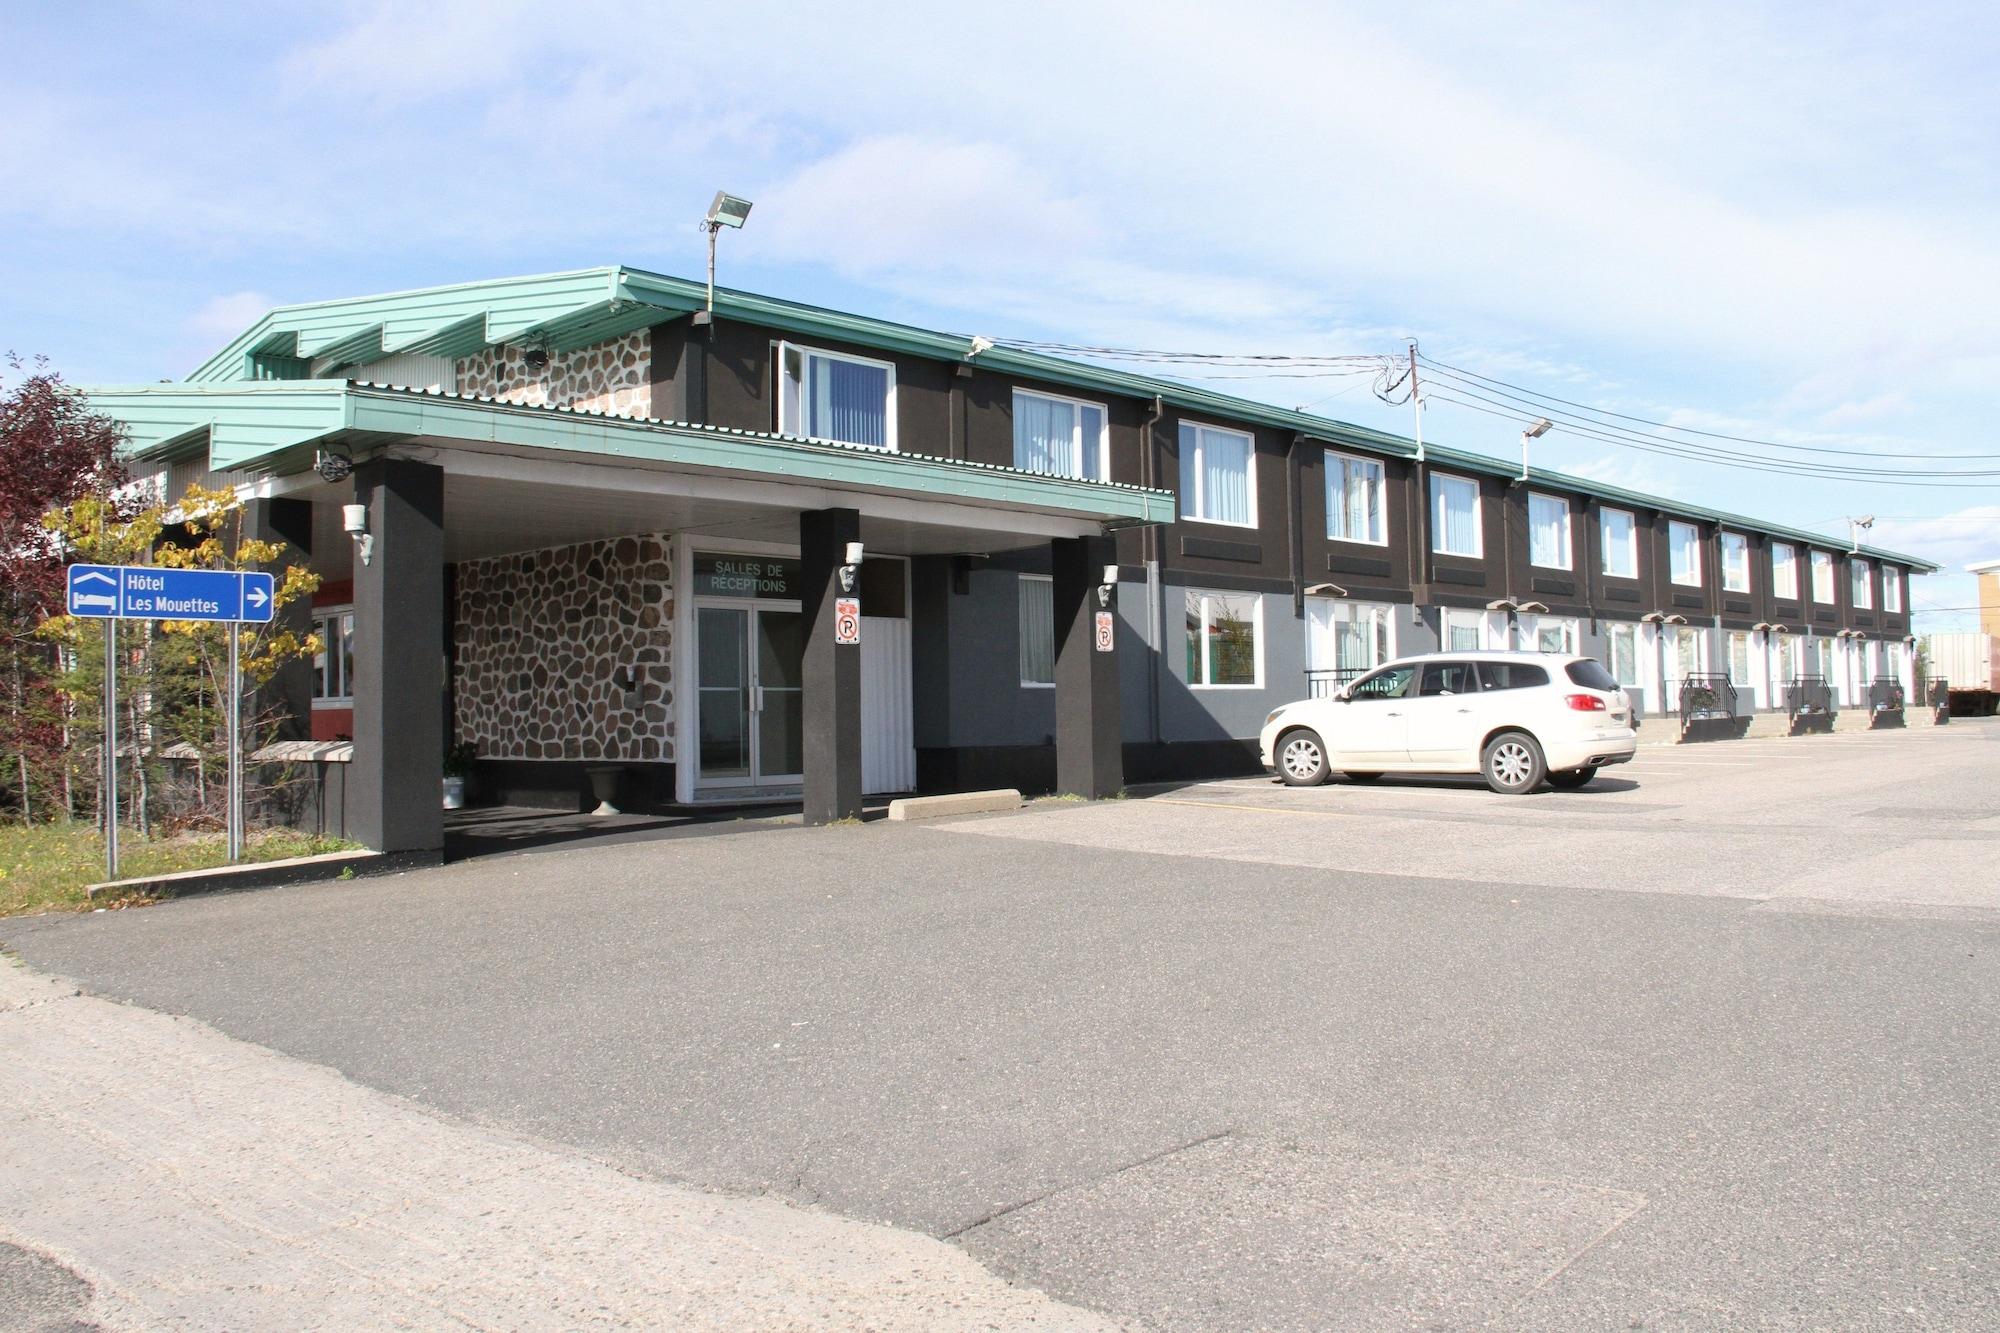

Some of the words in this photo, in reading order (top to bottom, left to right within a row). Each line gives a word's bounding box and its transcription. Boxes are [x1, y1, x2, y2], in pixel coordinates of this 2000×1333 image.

[715, 561, 760, 575] SALLES
[767, 564, 783, 577] DE
[127, 574, 164, 591] Hôtel
[127, 596, 152, 611] Les
[156, 596, 219, 613] Mouettes
